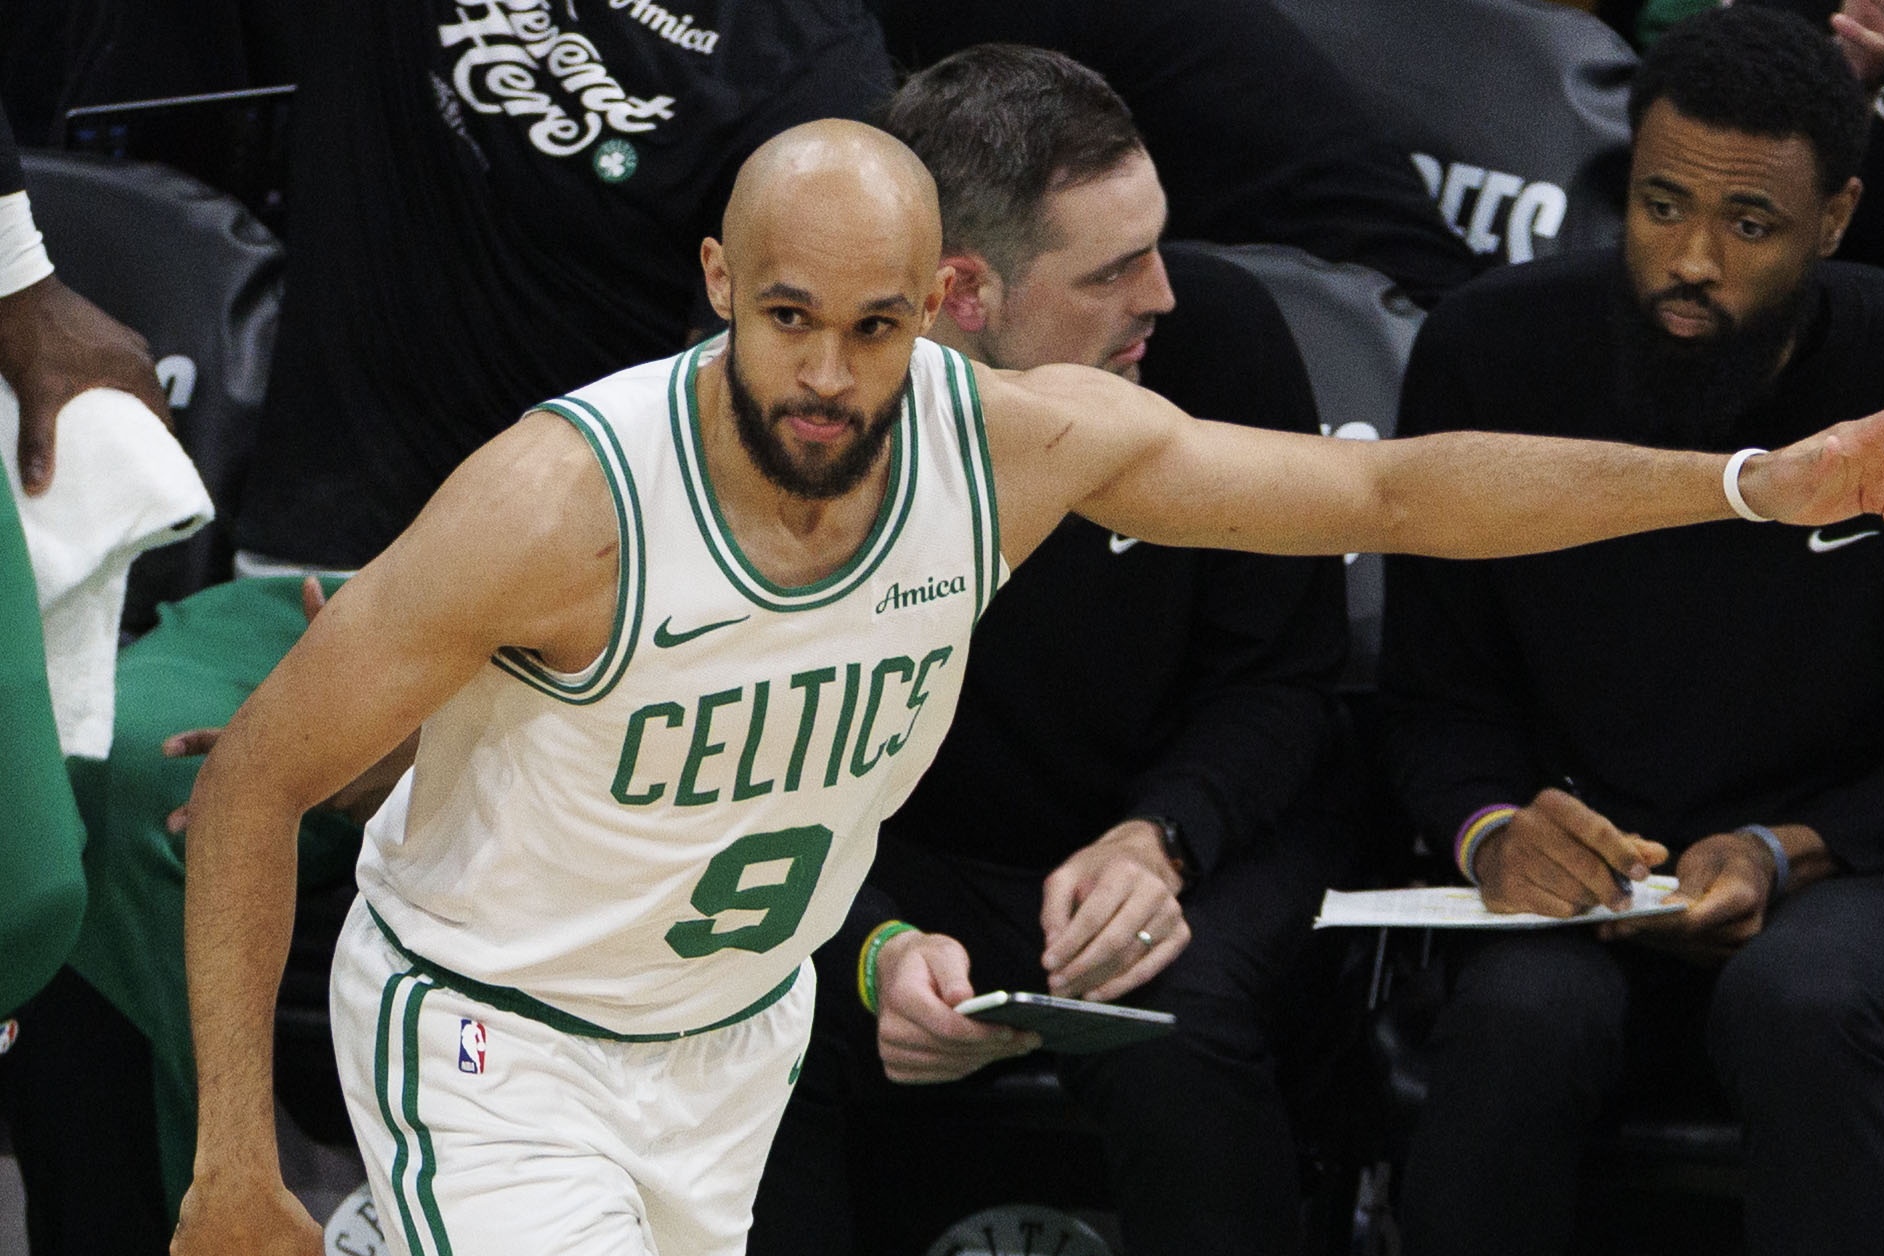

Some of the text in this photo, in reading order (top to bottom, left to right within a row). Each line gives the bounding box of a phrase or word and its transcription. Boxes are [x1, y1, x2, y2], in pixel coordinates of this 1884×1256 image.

[876, 575, 967, 614] Amica
[610, 645, 954, 807] CELTICS
[664, 824, 834, 959] 9
